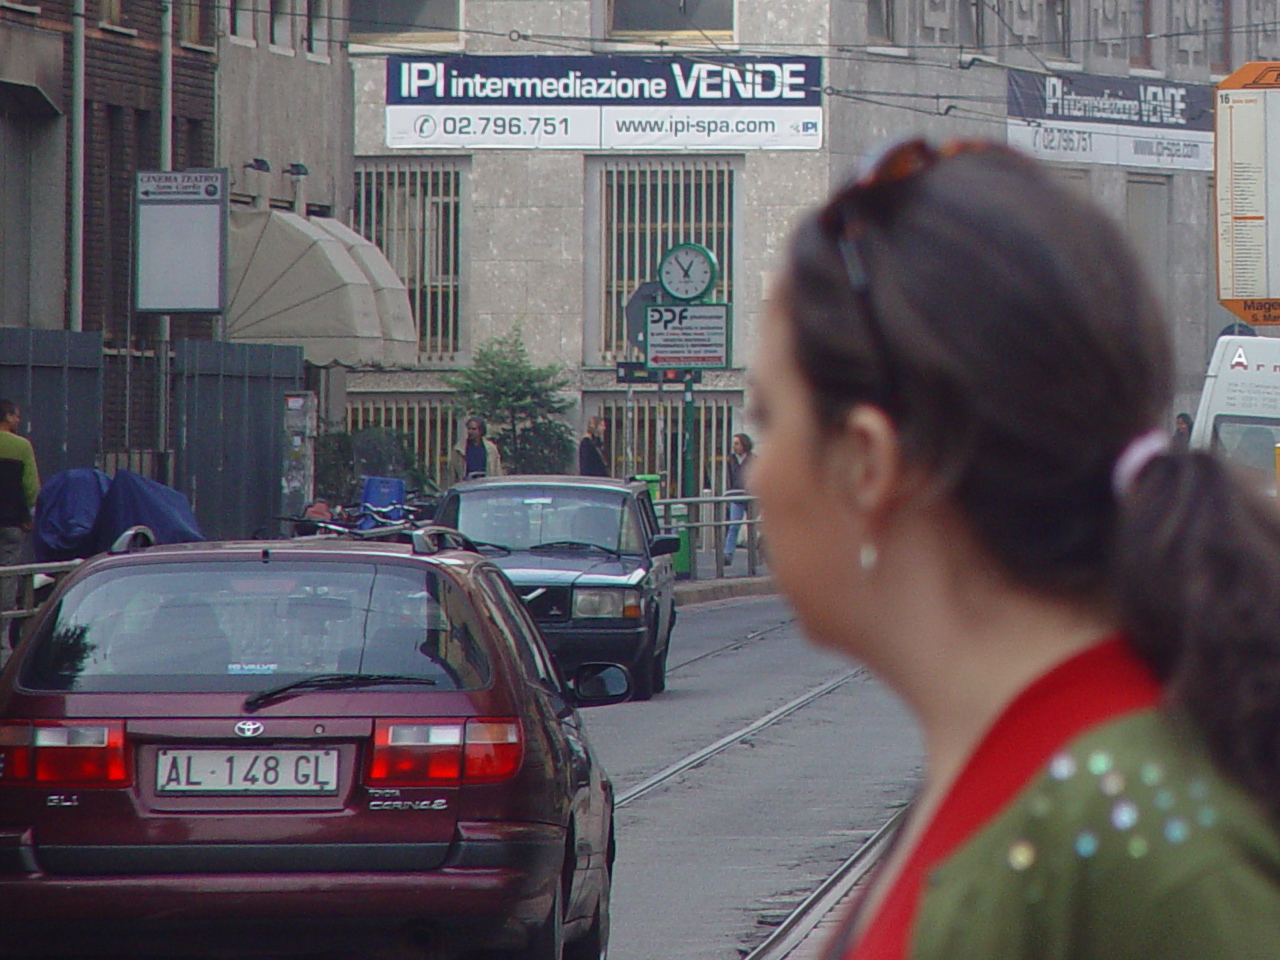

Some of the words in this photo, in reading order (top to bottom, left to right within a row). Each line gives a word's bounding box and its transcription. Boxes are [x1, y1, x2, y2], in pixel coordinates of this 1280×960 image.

[400, 62, 445, 98] IPI
[450, 69, 667, 99] intermediazione
[670, 62, 806, 99] VENDE
[443, 116, 570, 136] 02.796.751
[616, 115, 776, 137] www.ipi-spa.com
[801, 121, 818, 133] IPI
[141, 174, 178, 183] CINEMA
[180, 174, 219, 183] TEATRO
[166, 756, 202, 786] AL
[225, 755, 280, 786] 148
[294, 756, 330, 786] GL
